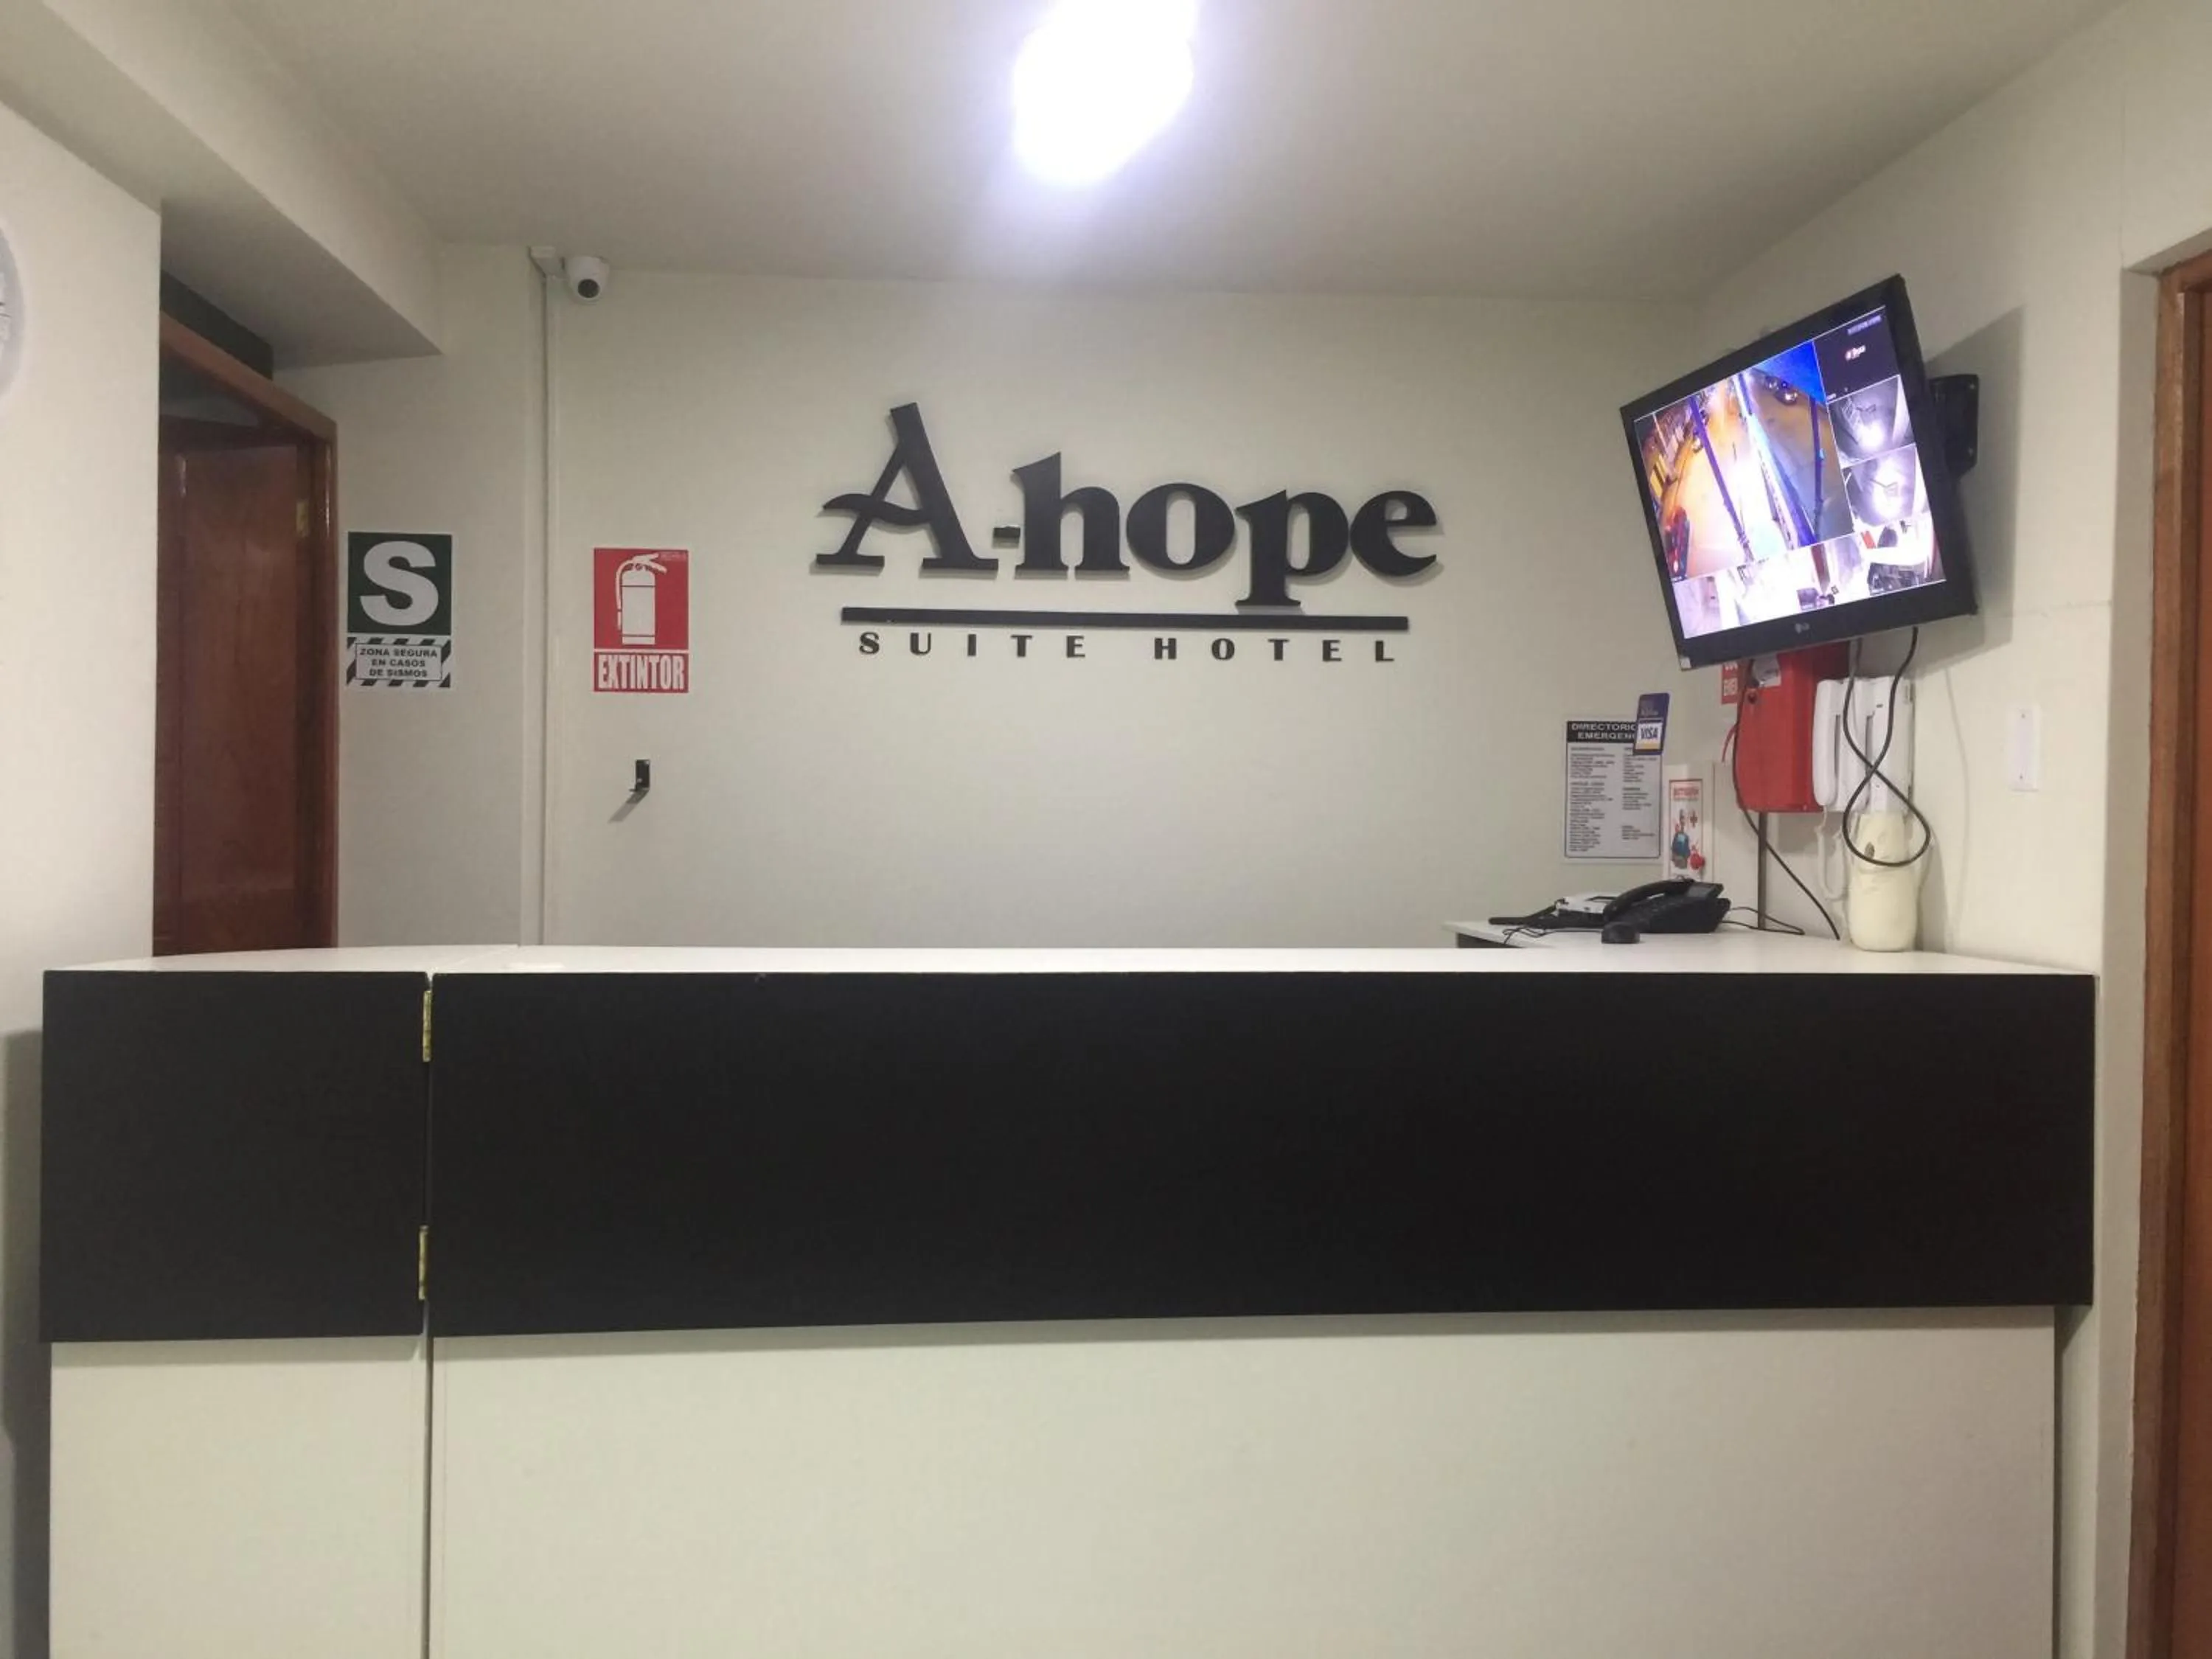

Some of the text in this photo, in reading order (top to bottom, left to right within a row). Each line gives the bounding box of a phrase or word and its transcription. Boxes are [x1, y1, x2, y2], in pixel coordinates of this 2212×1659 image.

[815, 403, 1438, 607] A-hope
[360, 540, 439, 626] S
[394, 649, 437, 658] SEGURA
[858, 632, 1394, 662] SUITE HOTEL
[369, 668, 428, 678] DE SISMOS
[389, 659, 425, 667] CASOS
[598, 654, 685, 690] EXTINTOR
[1641, 727, 1658, 740] VISA
